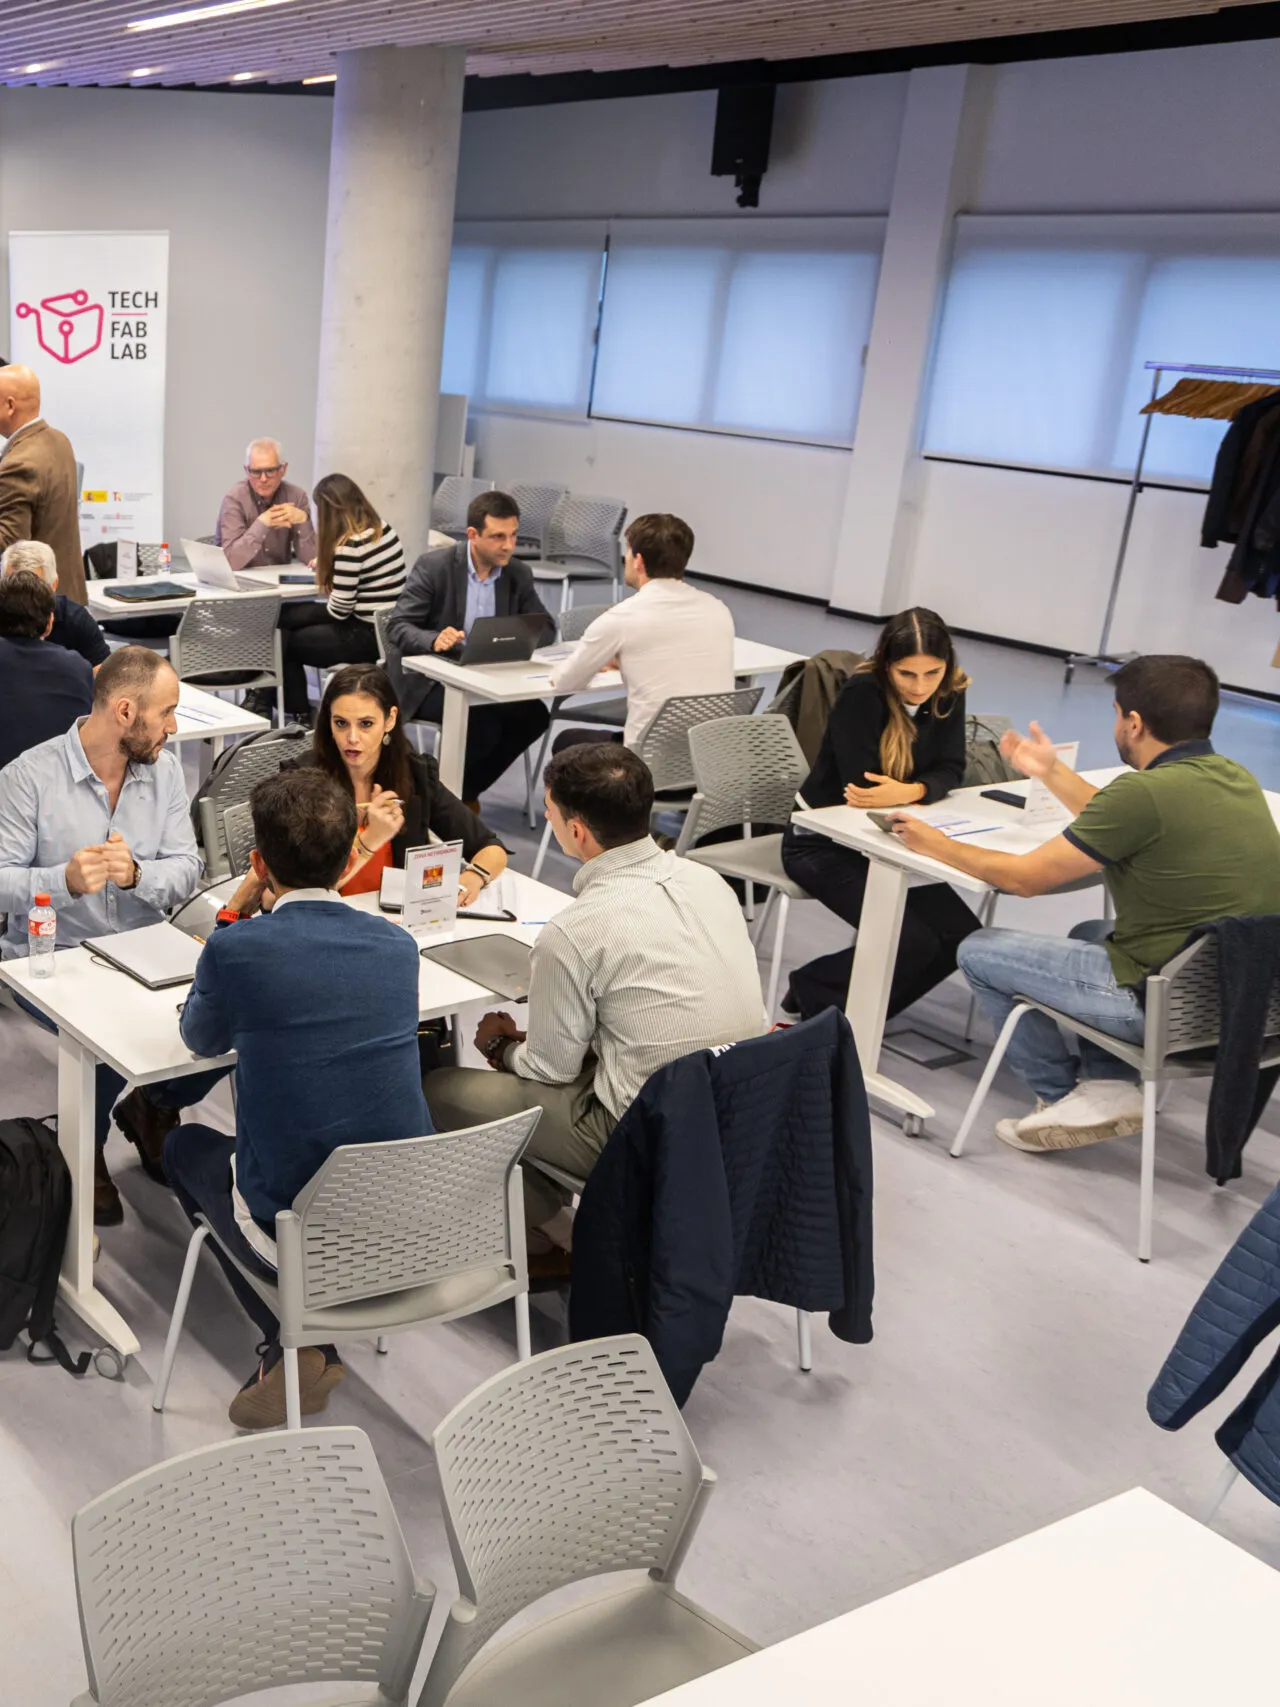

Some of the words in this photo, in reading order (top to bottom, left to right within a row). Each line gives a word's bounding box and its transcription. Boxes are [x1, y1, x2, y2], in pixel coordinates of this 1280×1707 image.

[108, 291, 158, 309] TECH
[111, 321, 148, 338] FAB
[111, 343, 148, 360] LAB
